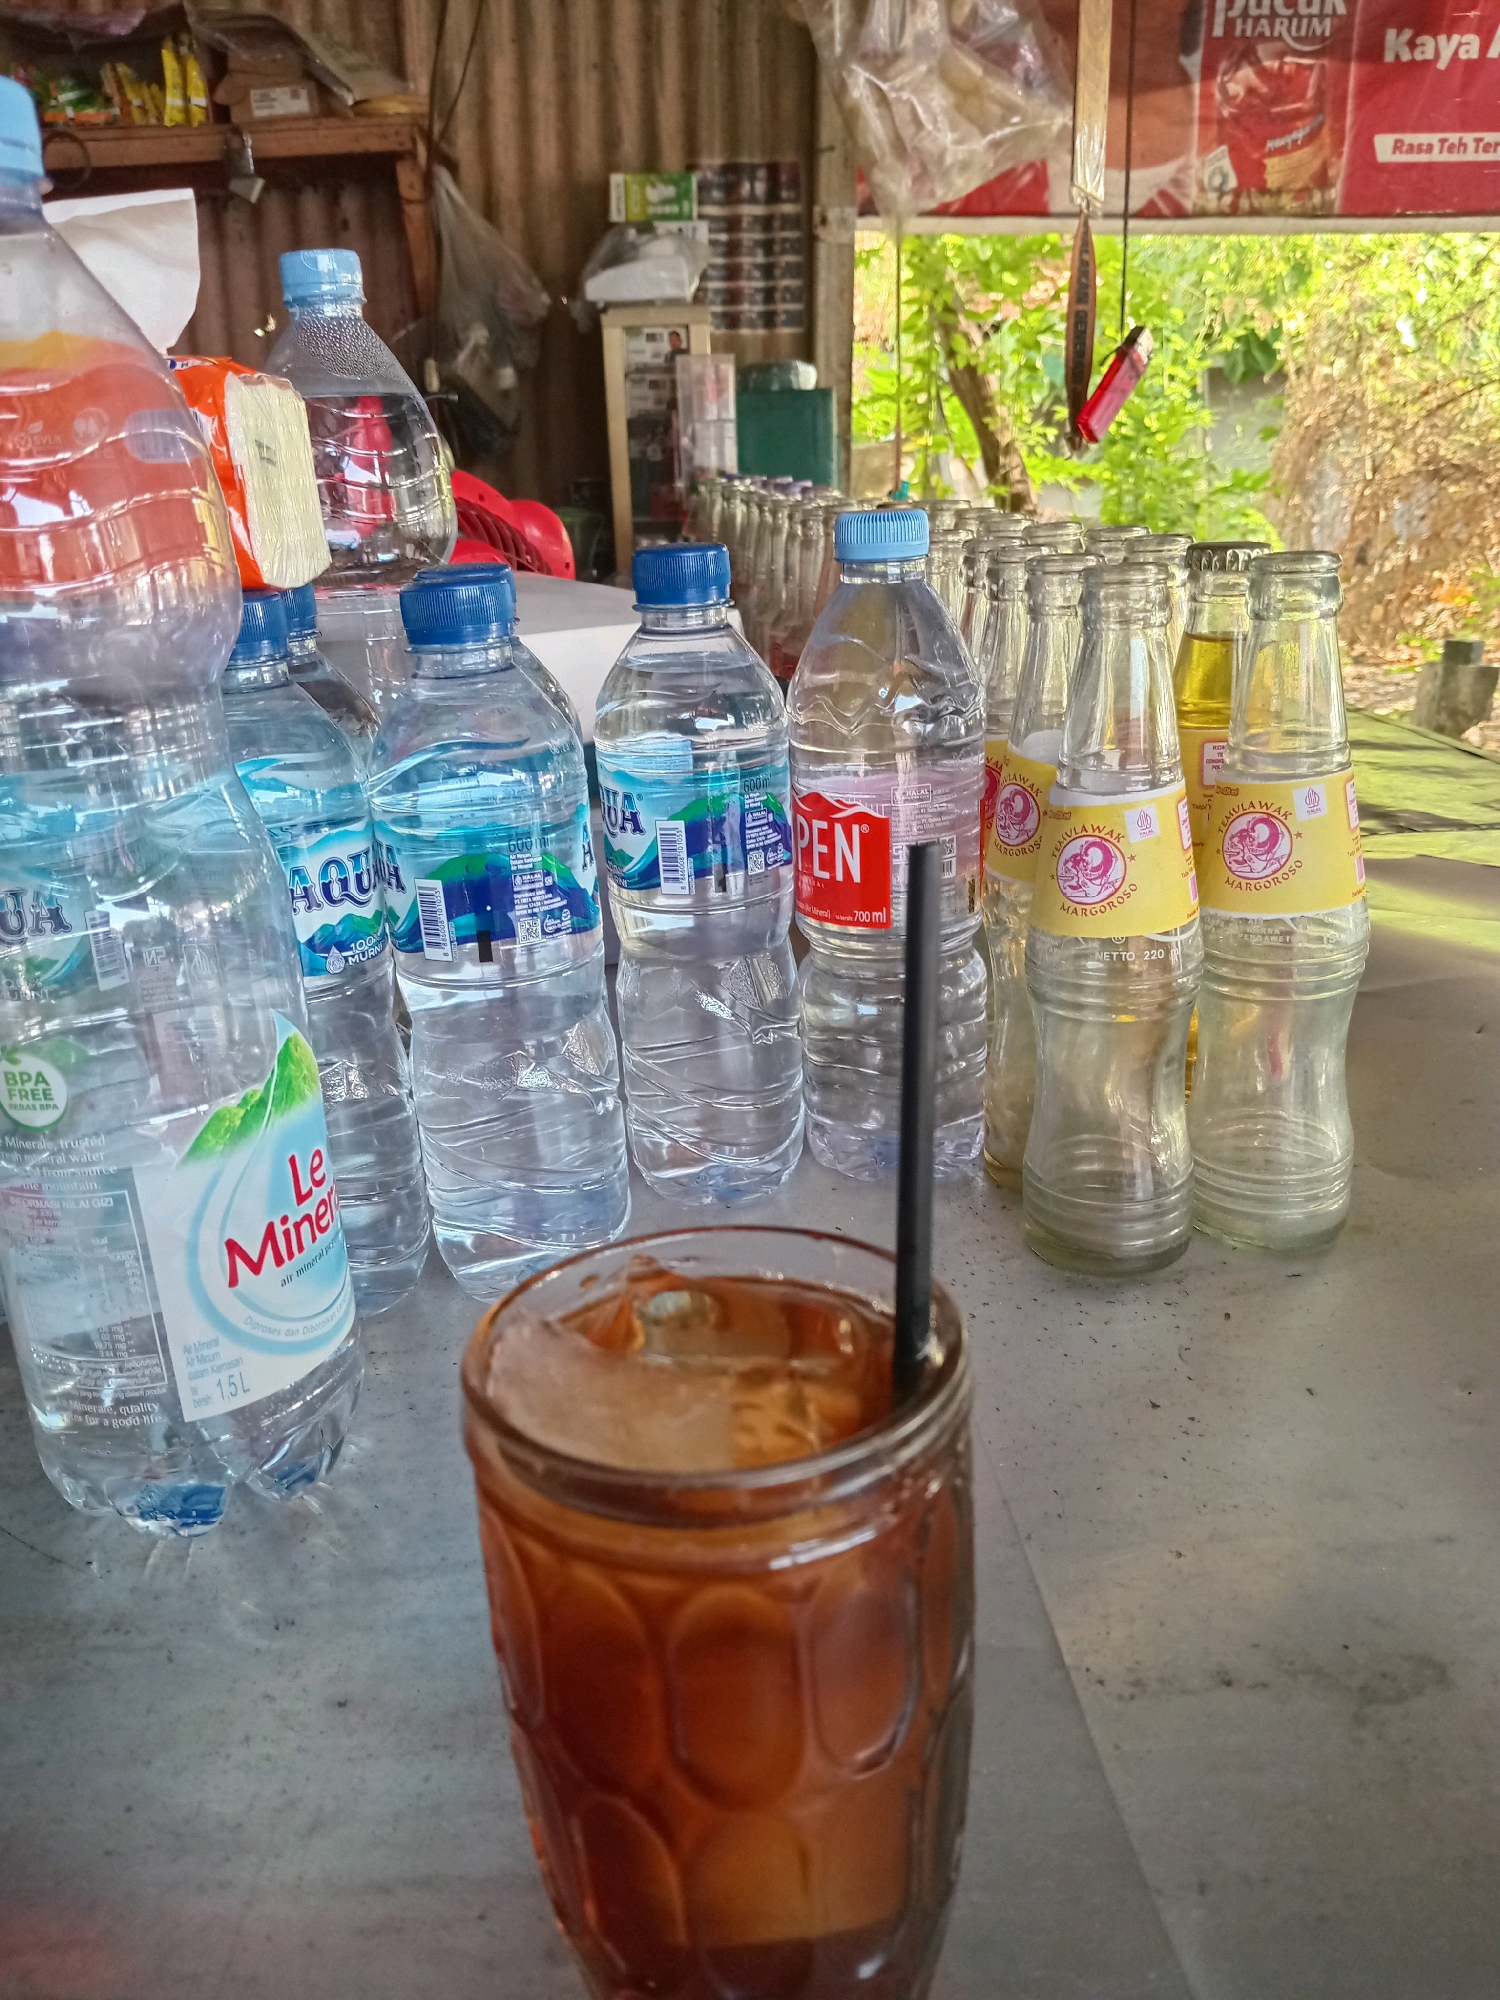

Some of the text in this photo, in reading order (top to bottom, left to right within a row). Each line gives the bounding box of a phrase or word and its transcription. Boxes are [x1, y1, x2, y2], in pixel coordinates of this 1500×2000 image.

[1234, 17, 1331, 41] HARUM
[1384, 28, 1480, 71] Kaya
[1392, 137, 1500, 155] Rasa Teh Ter
[744, 777, 761, 793] 600
[906, 788, 930, 797] HALAL
[599, 785, 646, 838] UA
[1218, 800, 1293, 834] TEMULAWAK
[508, 836, 533, 853] 600
[797, 814, 860, 884] PEN
[1052, 823, 1125, 858] TEMULAWAK
[288, 846, 376, 915] AQU
[1224, 859, 1303, 892] MARGOROSO
[1060, 882, 1138, 917] MARGOROSO
[854, 910, 870, 923] 700
[872, 907, 886, 923] ml
[1095, 951, 1135, 962] NETTO
[1143, 949, 1165, 961] 220
[4, 1071, 50, 1087] BPA
[7, 1087, 54, 1101] FREE
[5, 1135, 57, 1151] Minerale,
[288, 1148, 326, 1207] Le
[280, 1271, 294, 1287] air
[295, 1250, 325, 1278] mineral
[244, 1315, 282, 1337] Diproses
[284, 1327, 300, 1337] dan
[302, 1310, 337, 1336] Dibotolkan
[183, 1337, 220, 1355] Air Mineral
[186, 1351, 221, 1369] Air Minum
[210, 1356, 244, 1375] Kemasan
[119, 1402, 160, 1416] quality
[85, 1415, 99, 1426] for
[112, 1416, 140, 1429] good
